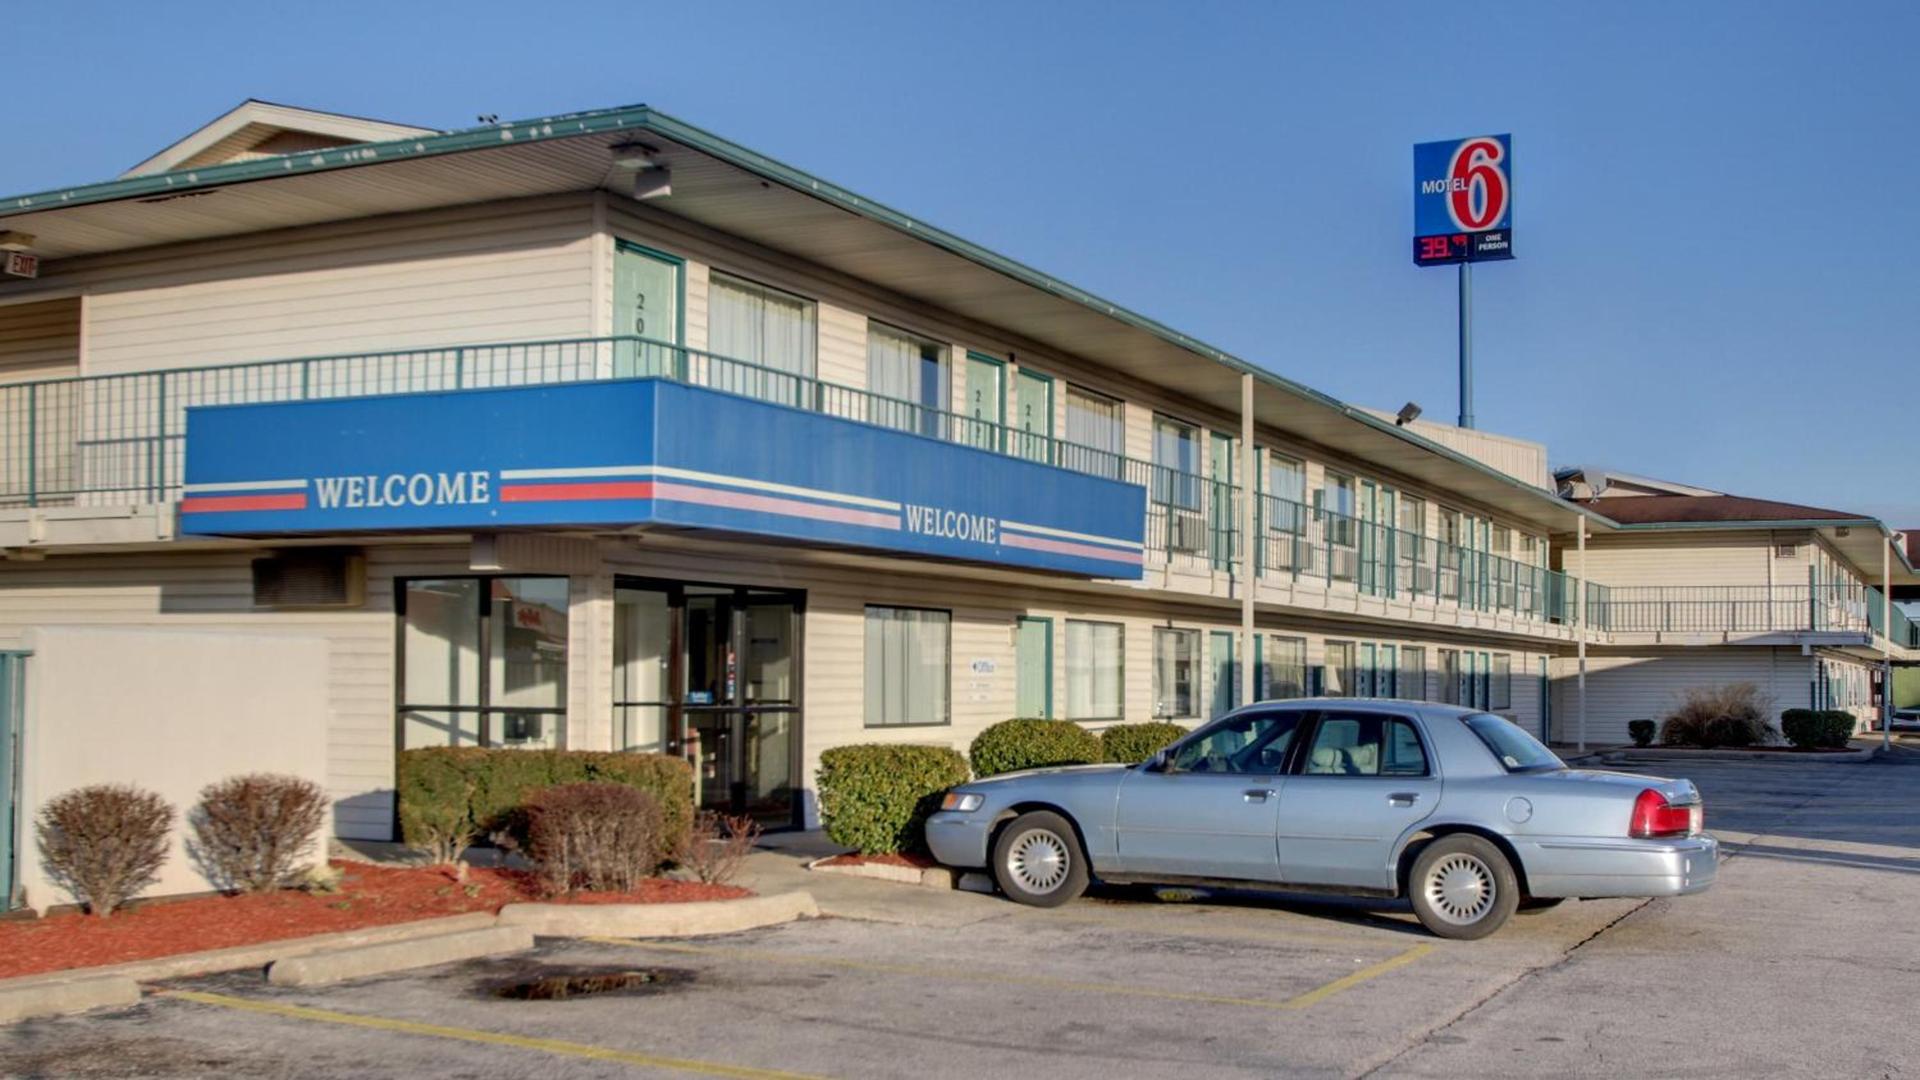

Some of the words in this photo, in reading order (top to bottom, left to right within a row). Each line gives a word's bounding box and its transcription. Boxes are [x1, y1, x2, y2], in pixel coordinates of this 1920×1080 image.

[1422, 178, 1468, 194] MOTEL
[1448, 139, 1507, 231] 6
[1478, 241, 1508, 251] PERSON
[1485, 233, 1502, 242] ONE
[314, 470, 490, 509] WELCOME
[905, 503, 996, 545] WELCOME
